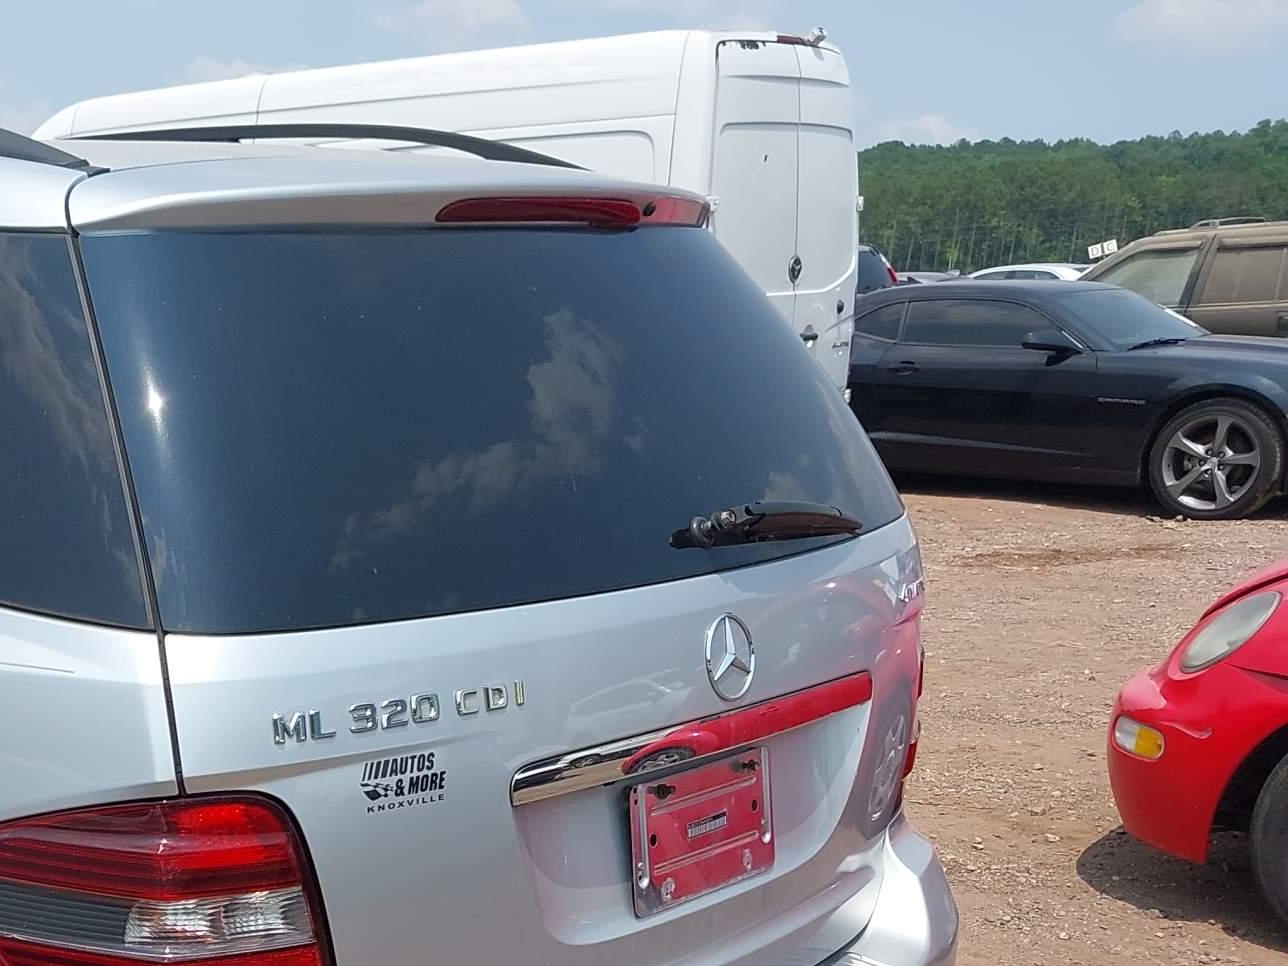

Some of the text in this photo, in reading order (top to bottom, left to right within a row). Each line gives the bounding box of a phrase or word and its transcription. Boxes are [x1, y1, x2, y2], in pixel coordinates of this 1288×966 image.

[271, 679, 525, 745] ML 320 CDI
[388, 752, 435, 777] AUTOS
[394, 770, 446, 797] & MORE
[367, 793, 445, 813] KNOXVILLE
